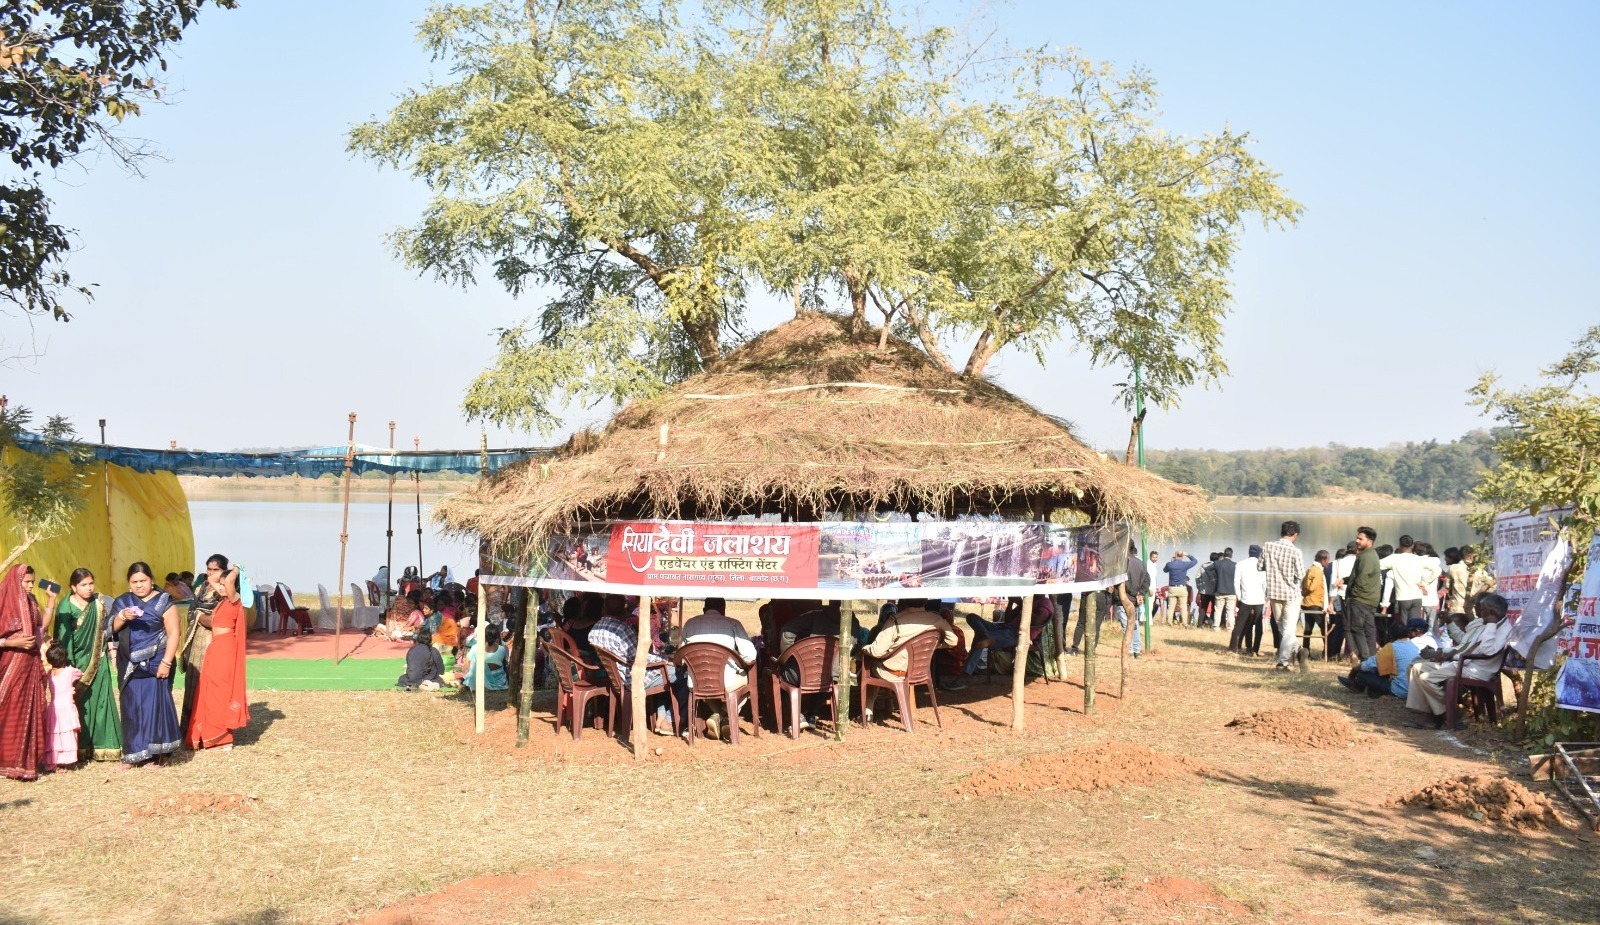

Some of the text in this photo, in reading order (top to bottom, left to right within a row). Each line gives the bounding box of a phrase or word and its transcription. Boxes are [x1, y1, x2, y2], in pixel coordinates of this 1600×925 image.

[703, 534, 791, 556] जलाशय
[659, 556, 697, 571] एडवेंचर
[700, 557, 715, 570] एंड
[756, 557, 778, 571] सेंटर
[646, 573, 658, 581] ग्राम
[659, 573, 681, 581] पंचायत
